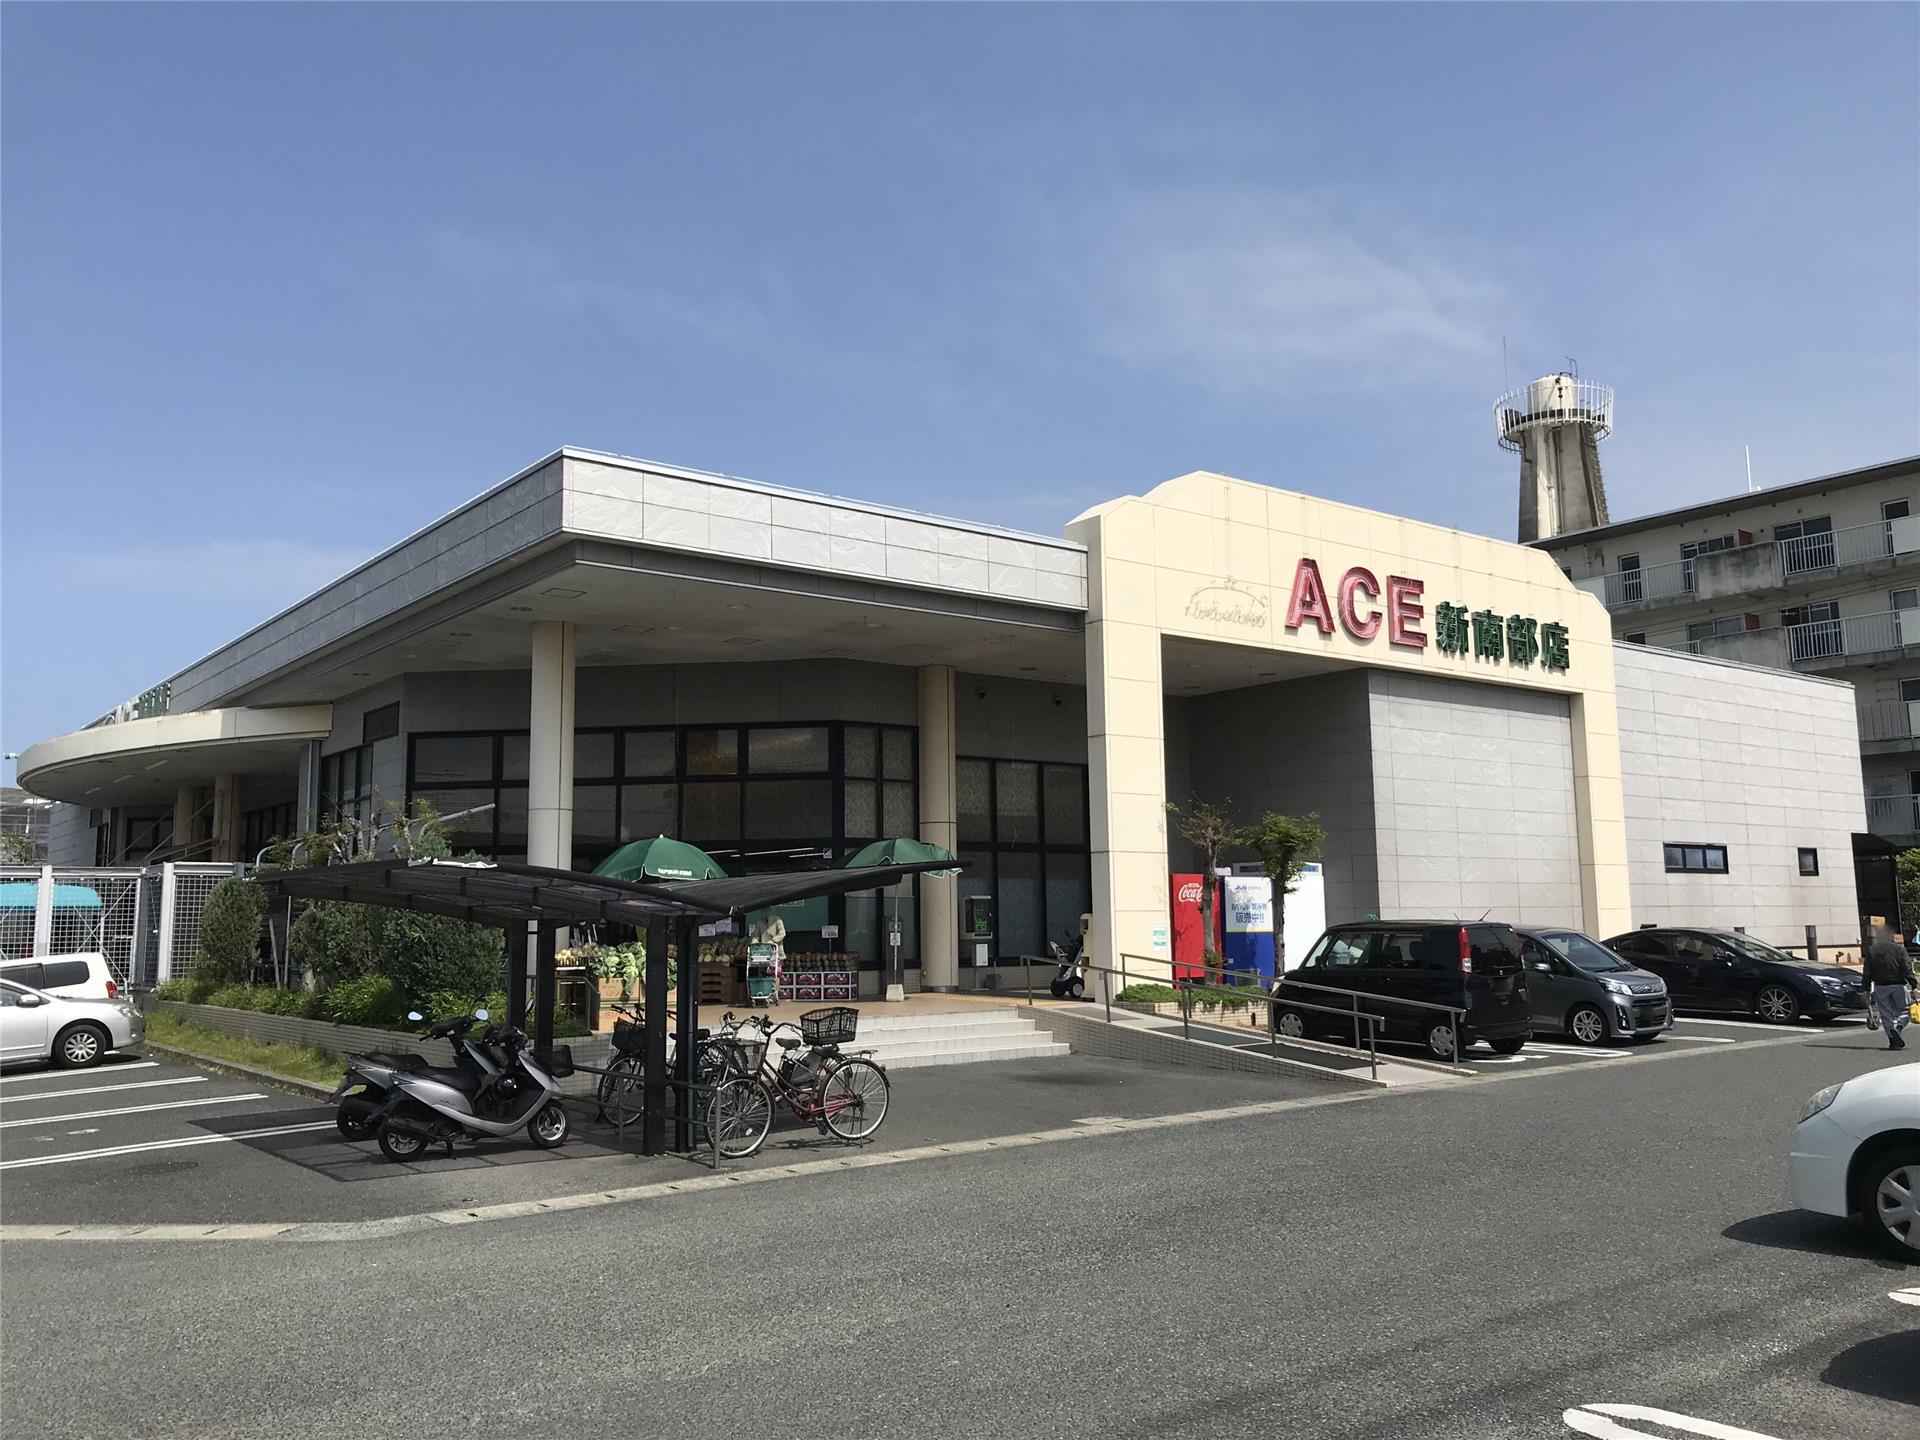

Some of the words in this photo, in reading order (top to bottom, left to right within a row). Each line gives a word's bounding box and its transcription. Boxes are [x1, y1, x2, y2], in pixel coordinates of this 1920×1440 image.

[1285, 557, 1428, 648] ACE
[1436, 601, 1570, 669] 新南部店
